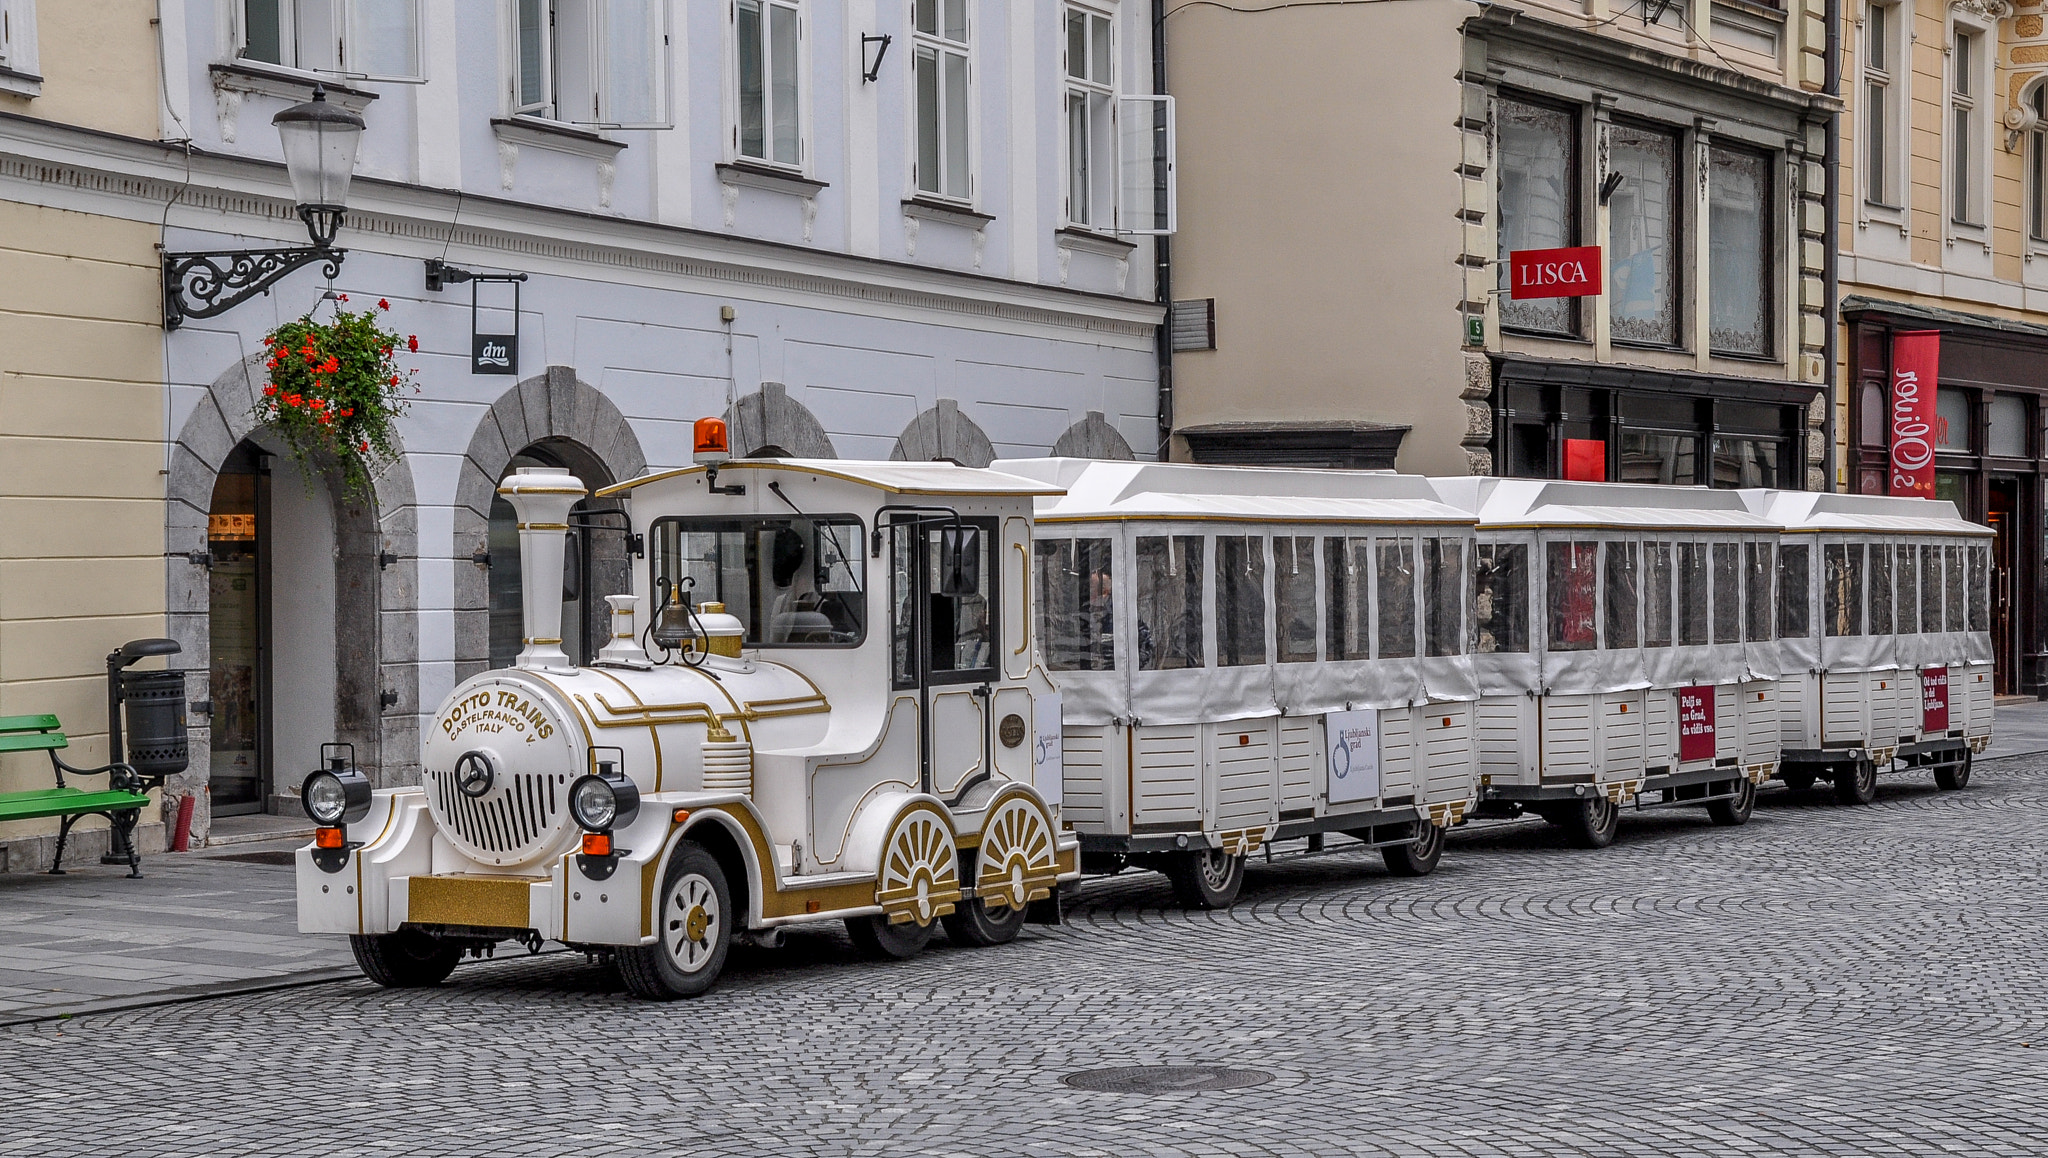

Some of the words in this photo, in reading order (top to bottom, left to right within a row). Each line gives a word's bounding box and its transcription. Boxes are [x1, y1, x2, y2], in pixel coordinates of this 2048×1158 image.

[1521, 260, 1588, 286] LISCA
[1475, 321, 1481, 334] 5
[482, 341, 506, 357] dm
[1682, 696, 1694, 708] Pelji
[1696, 698, 1702, 706] se
[442, 691, 491, 734] DOTTO
[497, 690, 554, 739] TRAINS
[1682, 713, 1689, 721] na
[1691, 709, 1705, 721] Grad,
[450, 710, 525, 742] CASTELFRANCO
[475, 723, 504, 734] ITALY
[1682, 724, 1689, 735] da
[1345, 727, 1371, 740] Ljubljanski
[1350, 740, 1361, 752] grad
